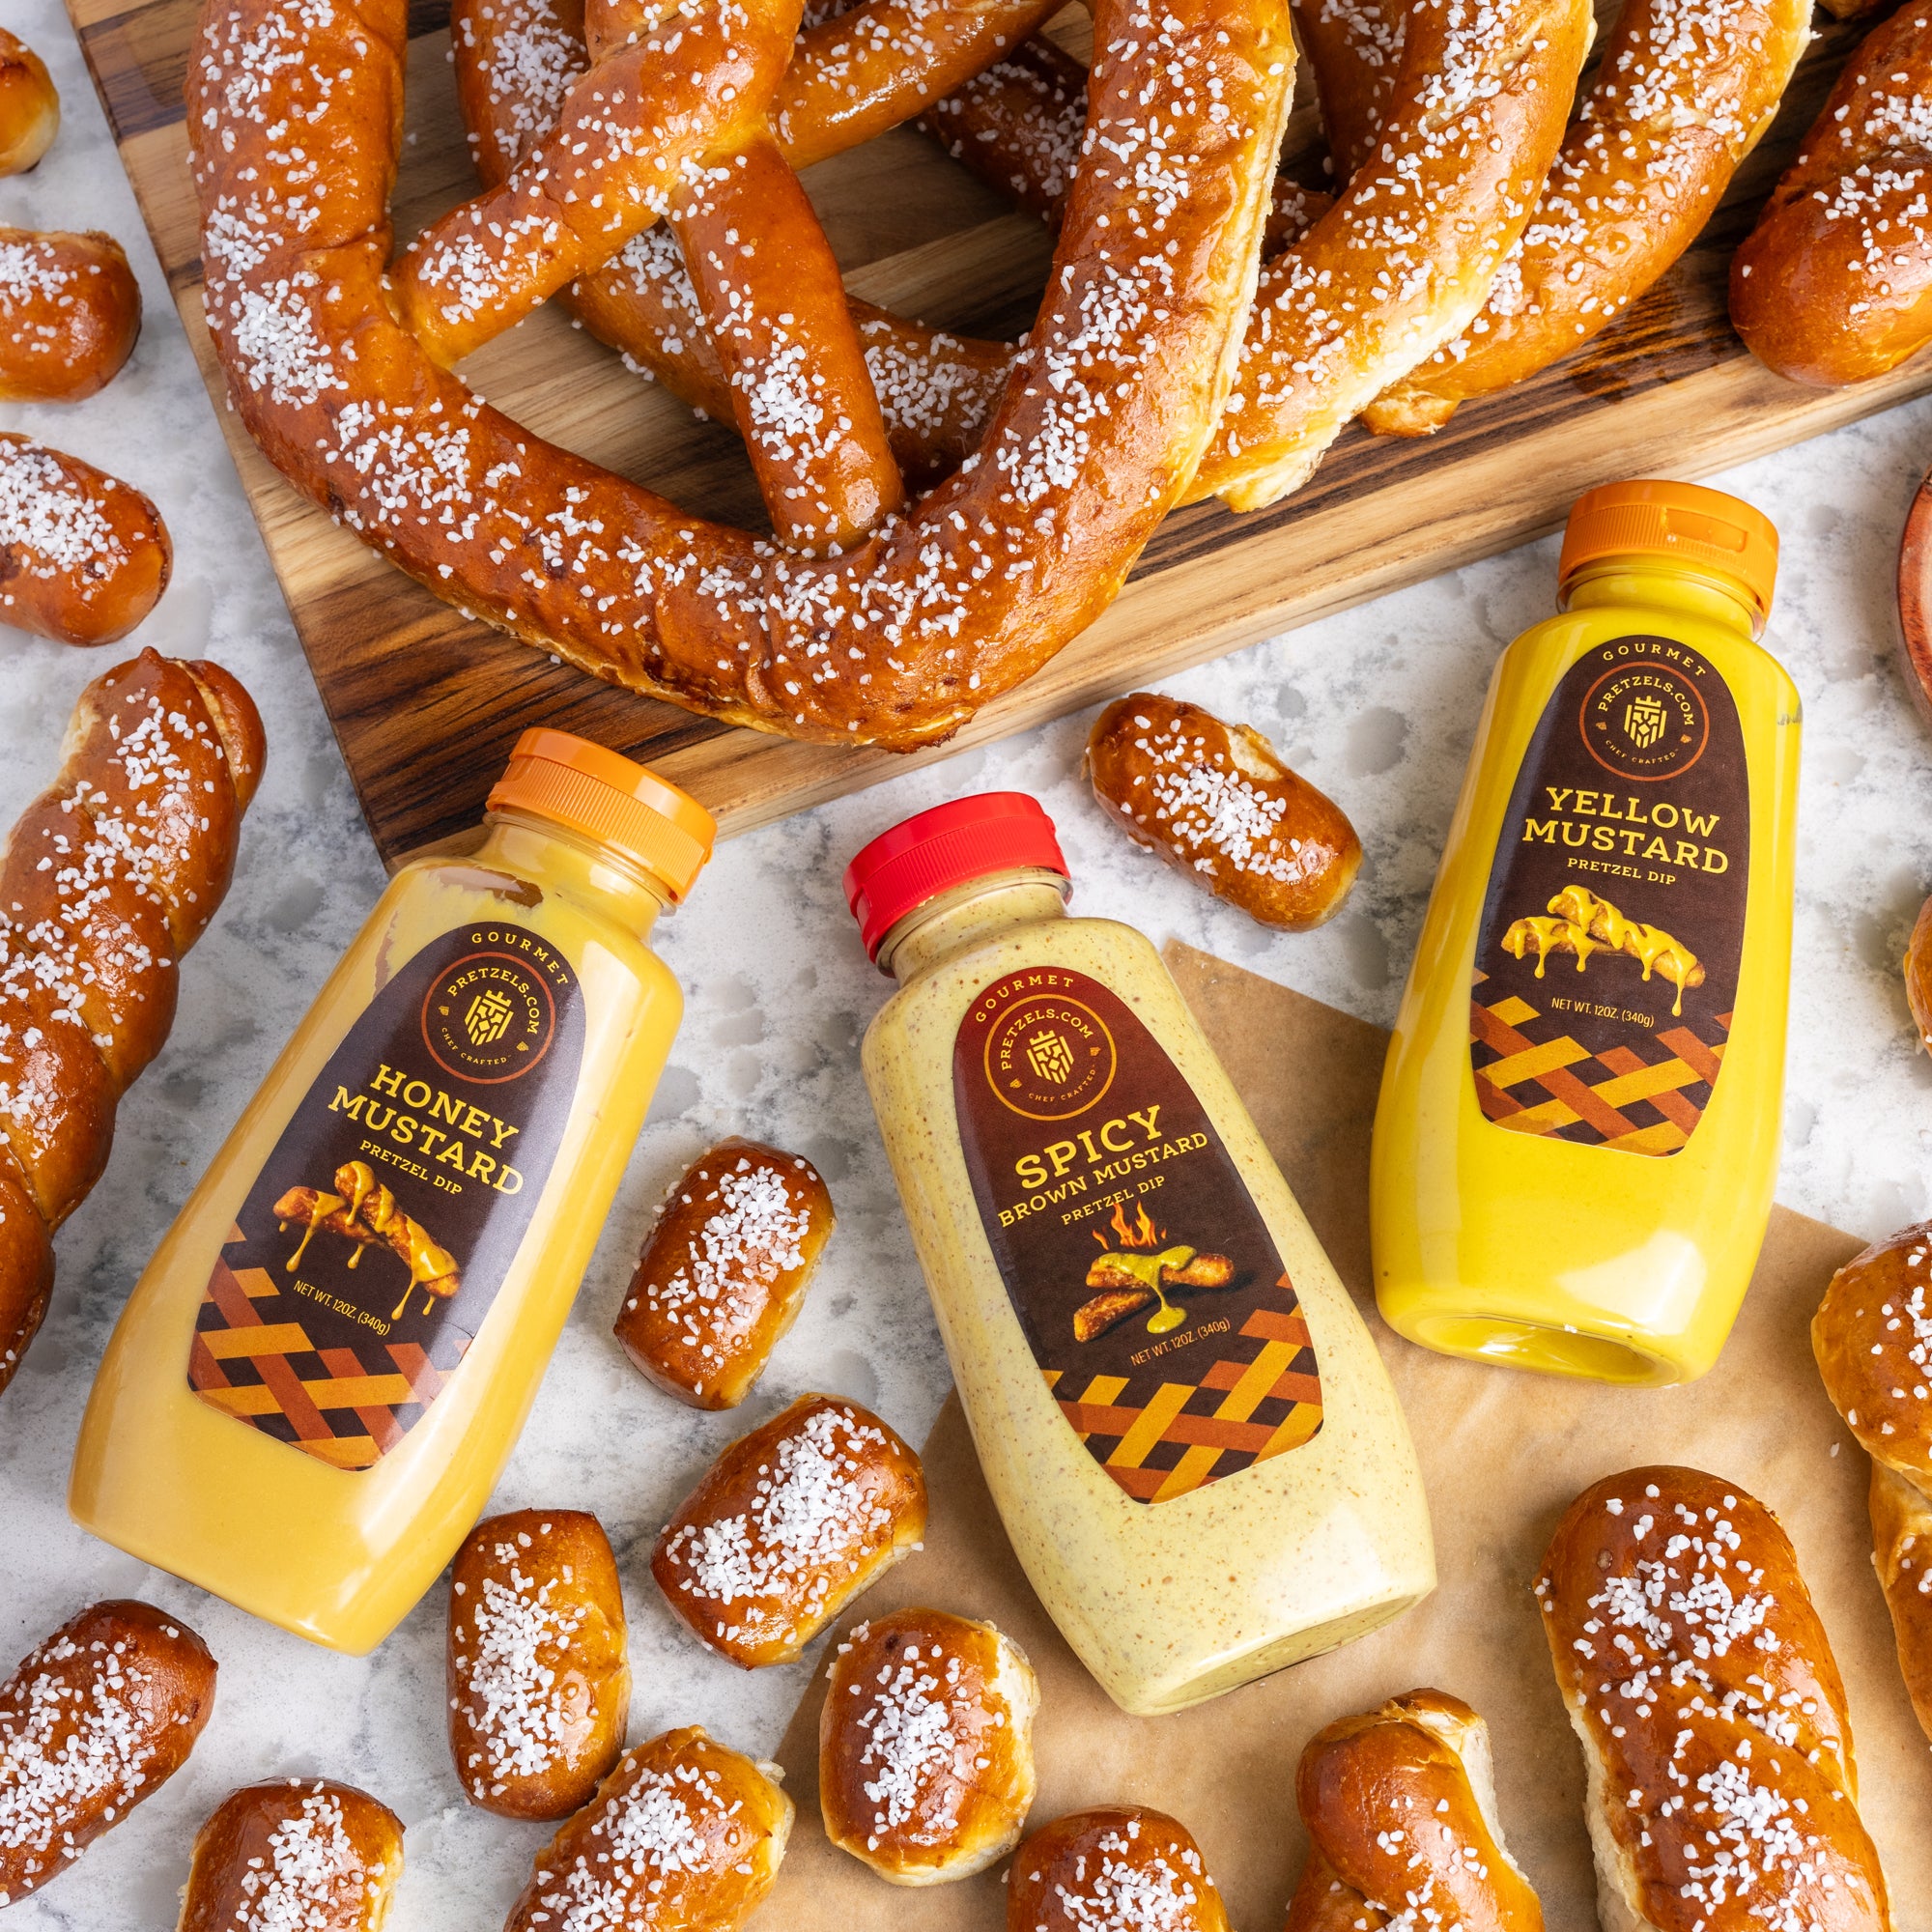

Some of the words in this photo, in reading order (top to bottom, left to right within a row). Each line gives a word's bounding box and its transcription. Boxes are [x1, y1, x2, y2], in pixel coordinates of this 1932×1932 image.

[1603, 643, 1706, 676] GOURMET
[1599, 676, 1694, 725] PRETZELS.COM
[1605, 740, 1627, 757] CHEF
[1547, 787, 1719, 838] YELLOW
[1522, 818, 1728, 874] MUSTARD
[1568, 858, 1641, 879] PRETZEL
[1648, 871, 1676, 885] DIP
[472, 931, 568, 984] GOURMET
[447, 968, 540, 1035] PRETZELS.COM
[976, 976, 1073, 1022] GOURMET
[1551, 998, 1572, 1009] NET
[1575, 1002, 1591, 1013] WT.
[1595, 1006, 1619, 1019] 12OZ.
[1622, 1009, 1654, 1027] (340g)
[442, 1028, 458, 1051] CHEF
[461, 1052, 506, 1065] CRAFTED
[1001, 1009, 1094, 1070] PRETZELS.COM
[370, 1065, 519, 1149] HONEY
[1029, 1093, 1055, 1102] CHEF
[1061, 1069, 1095, 1100] CRAFTED
[328, 1086, 524, 1195] MUSTARD
[1015, 1105, 1162, 1189] SPICY
[359, 1140, 428, 1180] PRETZEL
[433, 1176, 463, 1195] DIP
[998, 1177, 1087, 1227] BROWN
[1093, 1132, 1208, 1184] MUSTARD
[1062, 1189, 1134, 1225] PRETZEL
[1138, 1176, 1165, 1193] DIP
[294, 1280, 315, 1296] NET
[315, 1290, 332, 1306] WT.
[332, 1299, 357, 1319] 12OZ.
[357, 1312, 390, 1336] (340g)
[1130, 1349, 1151, 1366] NET
[1151, 1342, 1171, 1356] WT.
[1198, 1317, 1231, 1340] (340g)
